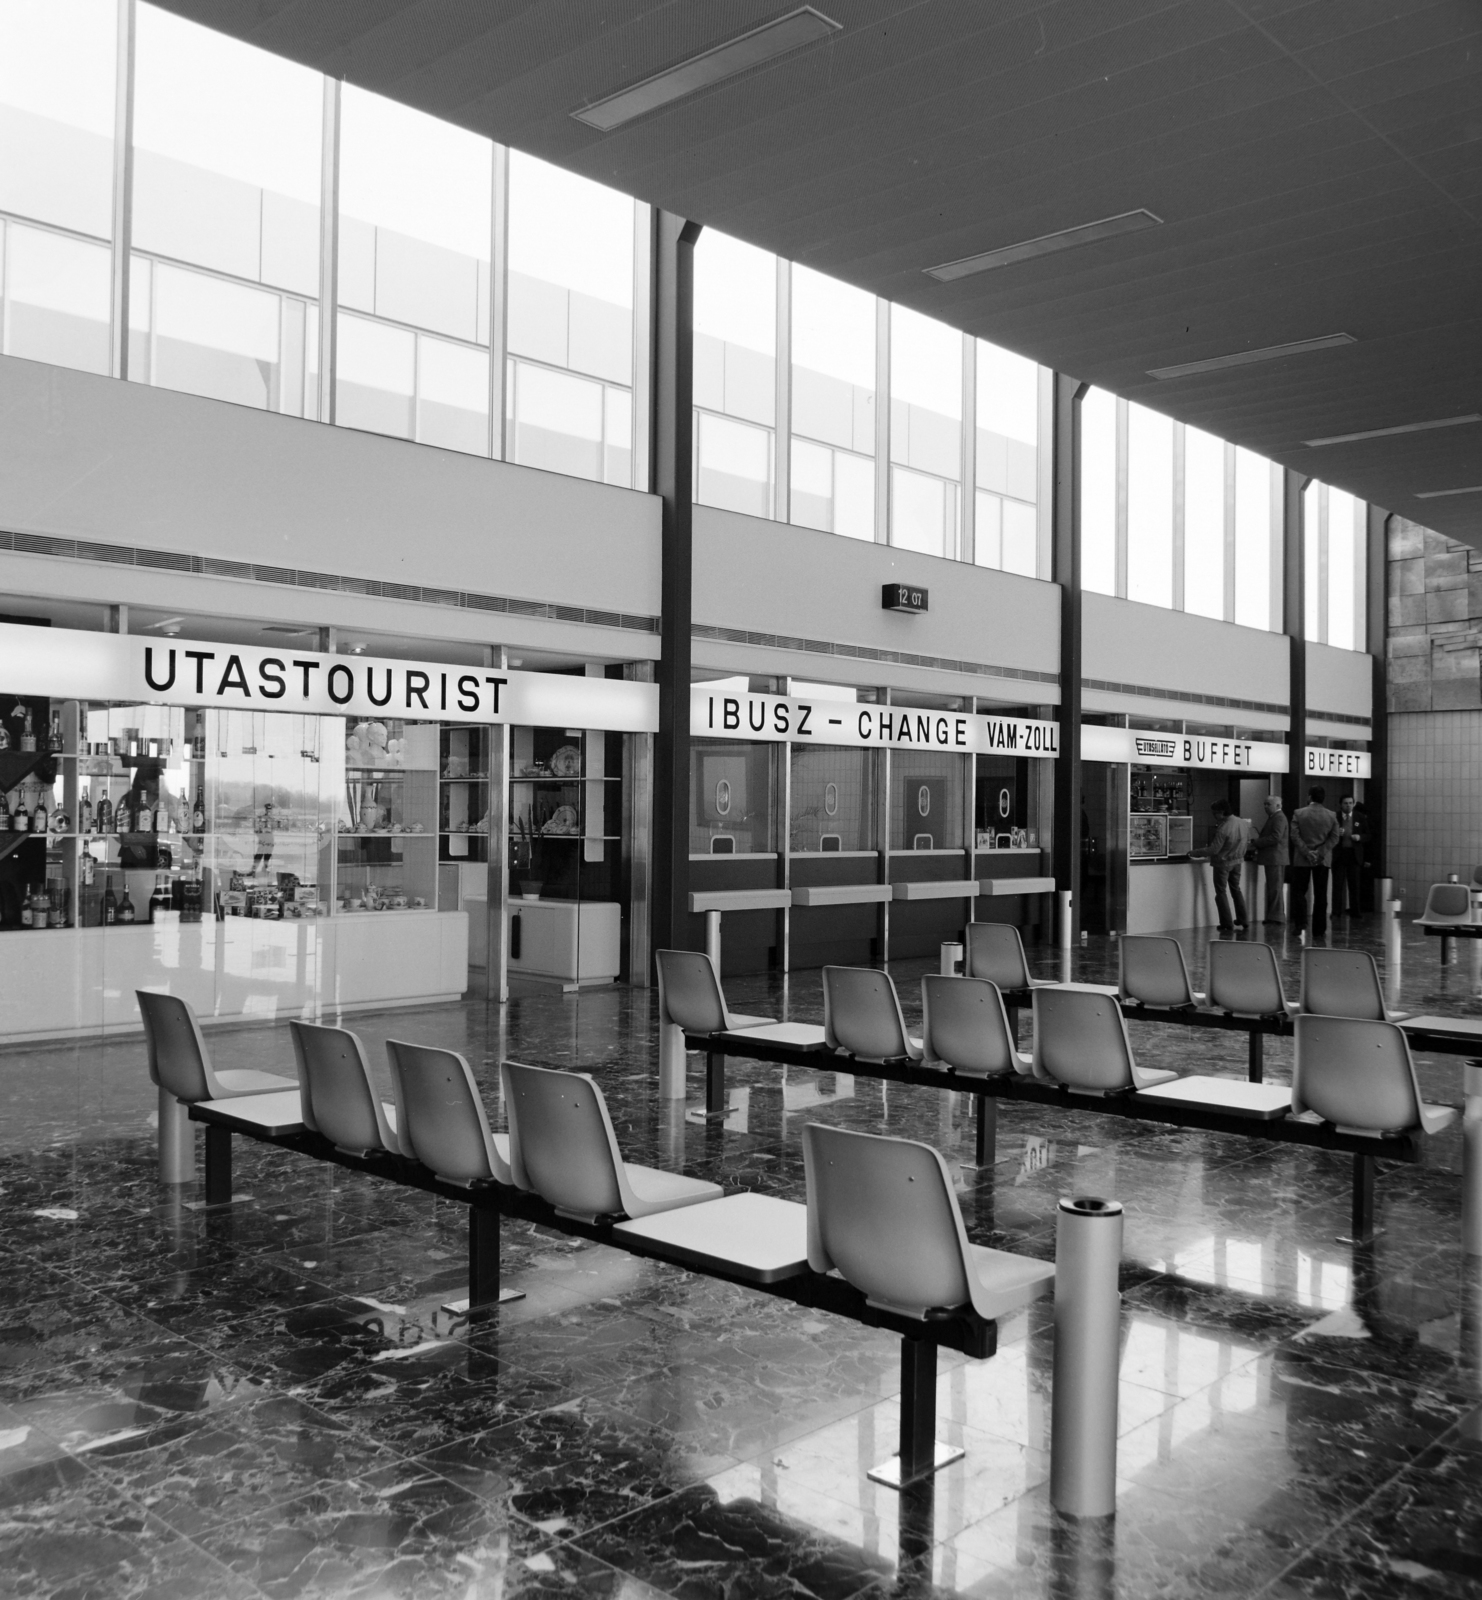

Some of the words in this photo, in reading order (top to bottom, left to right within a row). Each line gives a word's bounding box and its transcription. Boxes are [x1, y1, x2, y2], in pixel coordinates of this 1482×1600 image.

[898, 588, 908, 604] 12
[911, 592, 922, 606] 07
[144, 646, 509, 714] UTASTOURIST
[708, 696, 812, 735] IBUSZ
[857, 710, 967, 746] CHANGE
[1183, 739, 1253, 766] BUFFET
[1308, 751, 1361, 774] BUFFET
